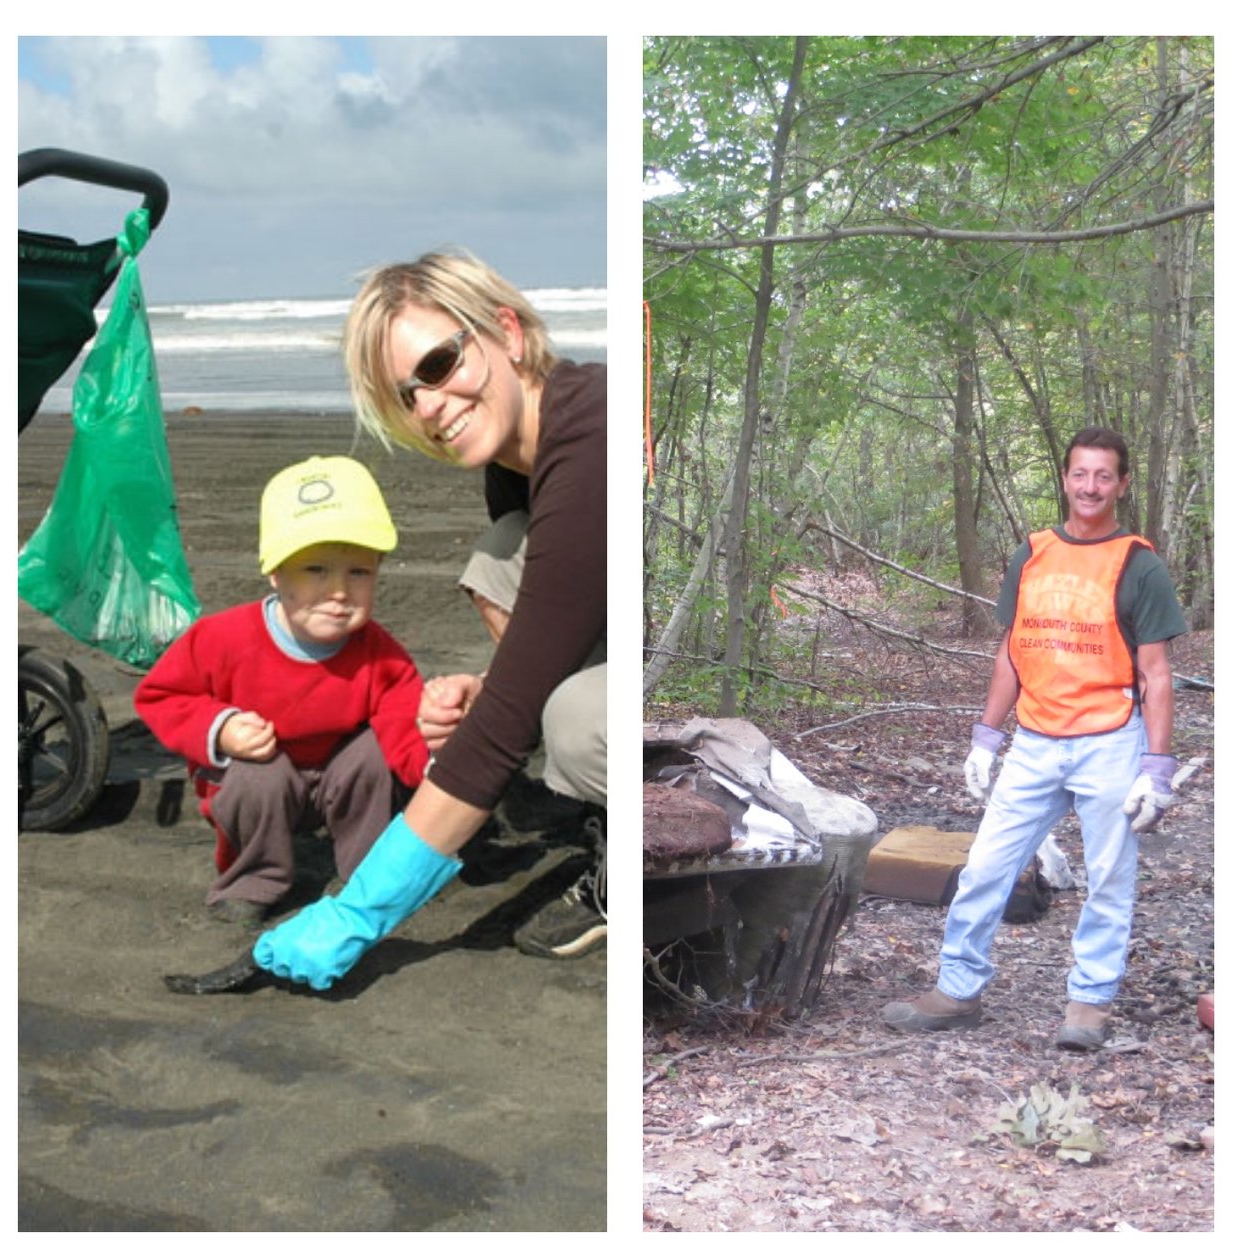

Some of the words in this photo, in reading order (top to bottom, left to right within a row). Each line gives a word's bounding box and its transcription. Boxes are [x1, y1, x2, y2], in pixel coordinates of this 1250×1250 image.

[1021, 617, 1068, 632] MONMOUTH
[1070, 621, 1104, 634] COUNTY
[1019, 637, 1043, 649] CLEAN
[1044, 638, 1104, 656] COMMUNITIES
